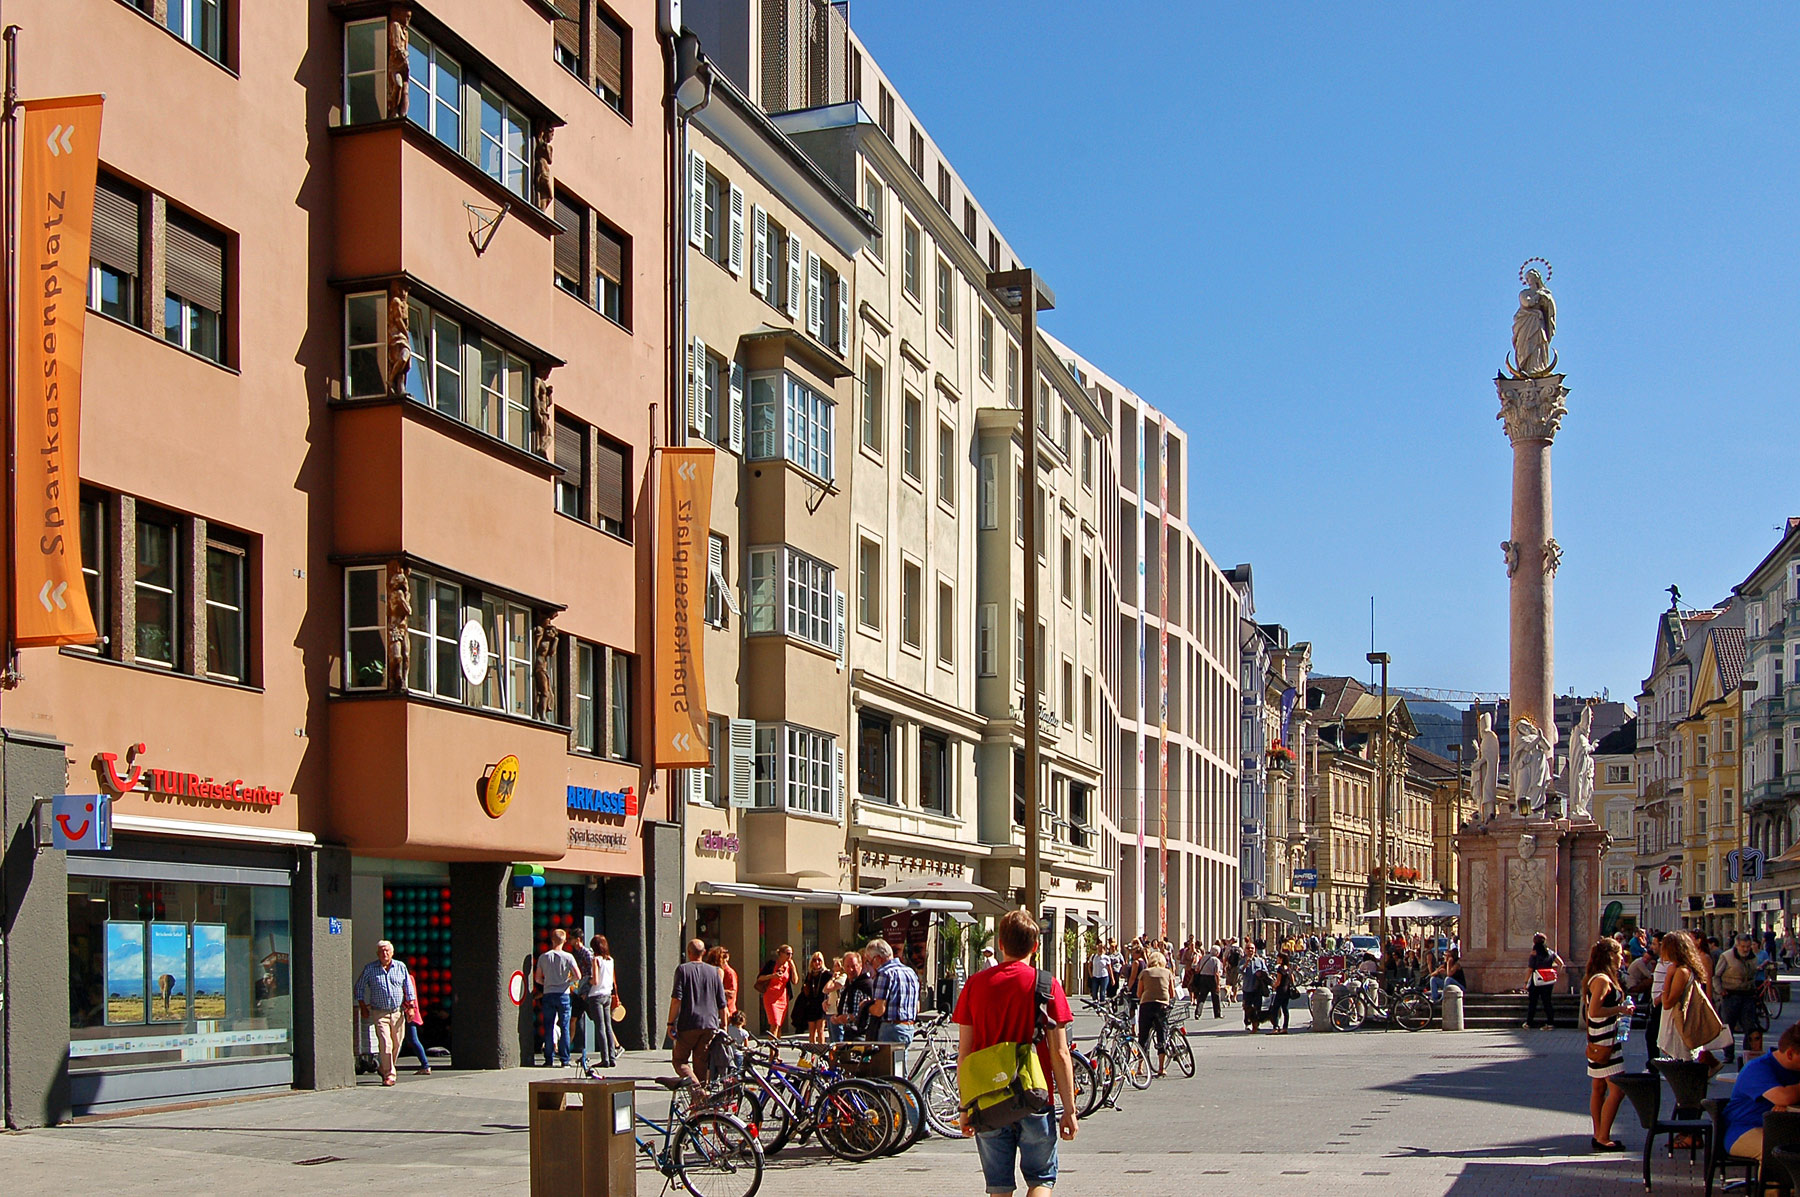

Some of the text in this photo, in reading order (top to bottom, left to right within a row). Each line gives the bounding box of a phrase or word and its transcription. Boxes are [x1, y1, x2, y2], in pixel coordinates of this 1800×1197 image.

[40, 189, 66, 556] Sparkassenplatz
[152, 769, 284, 806] TUI ReiseCenter
[567, 785, 625, 815] ARKASSE
[569, 827, 627, 847] Sparkassenplatz
